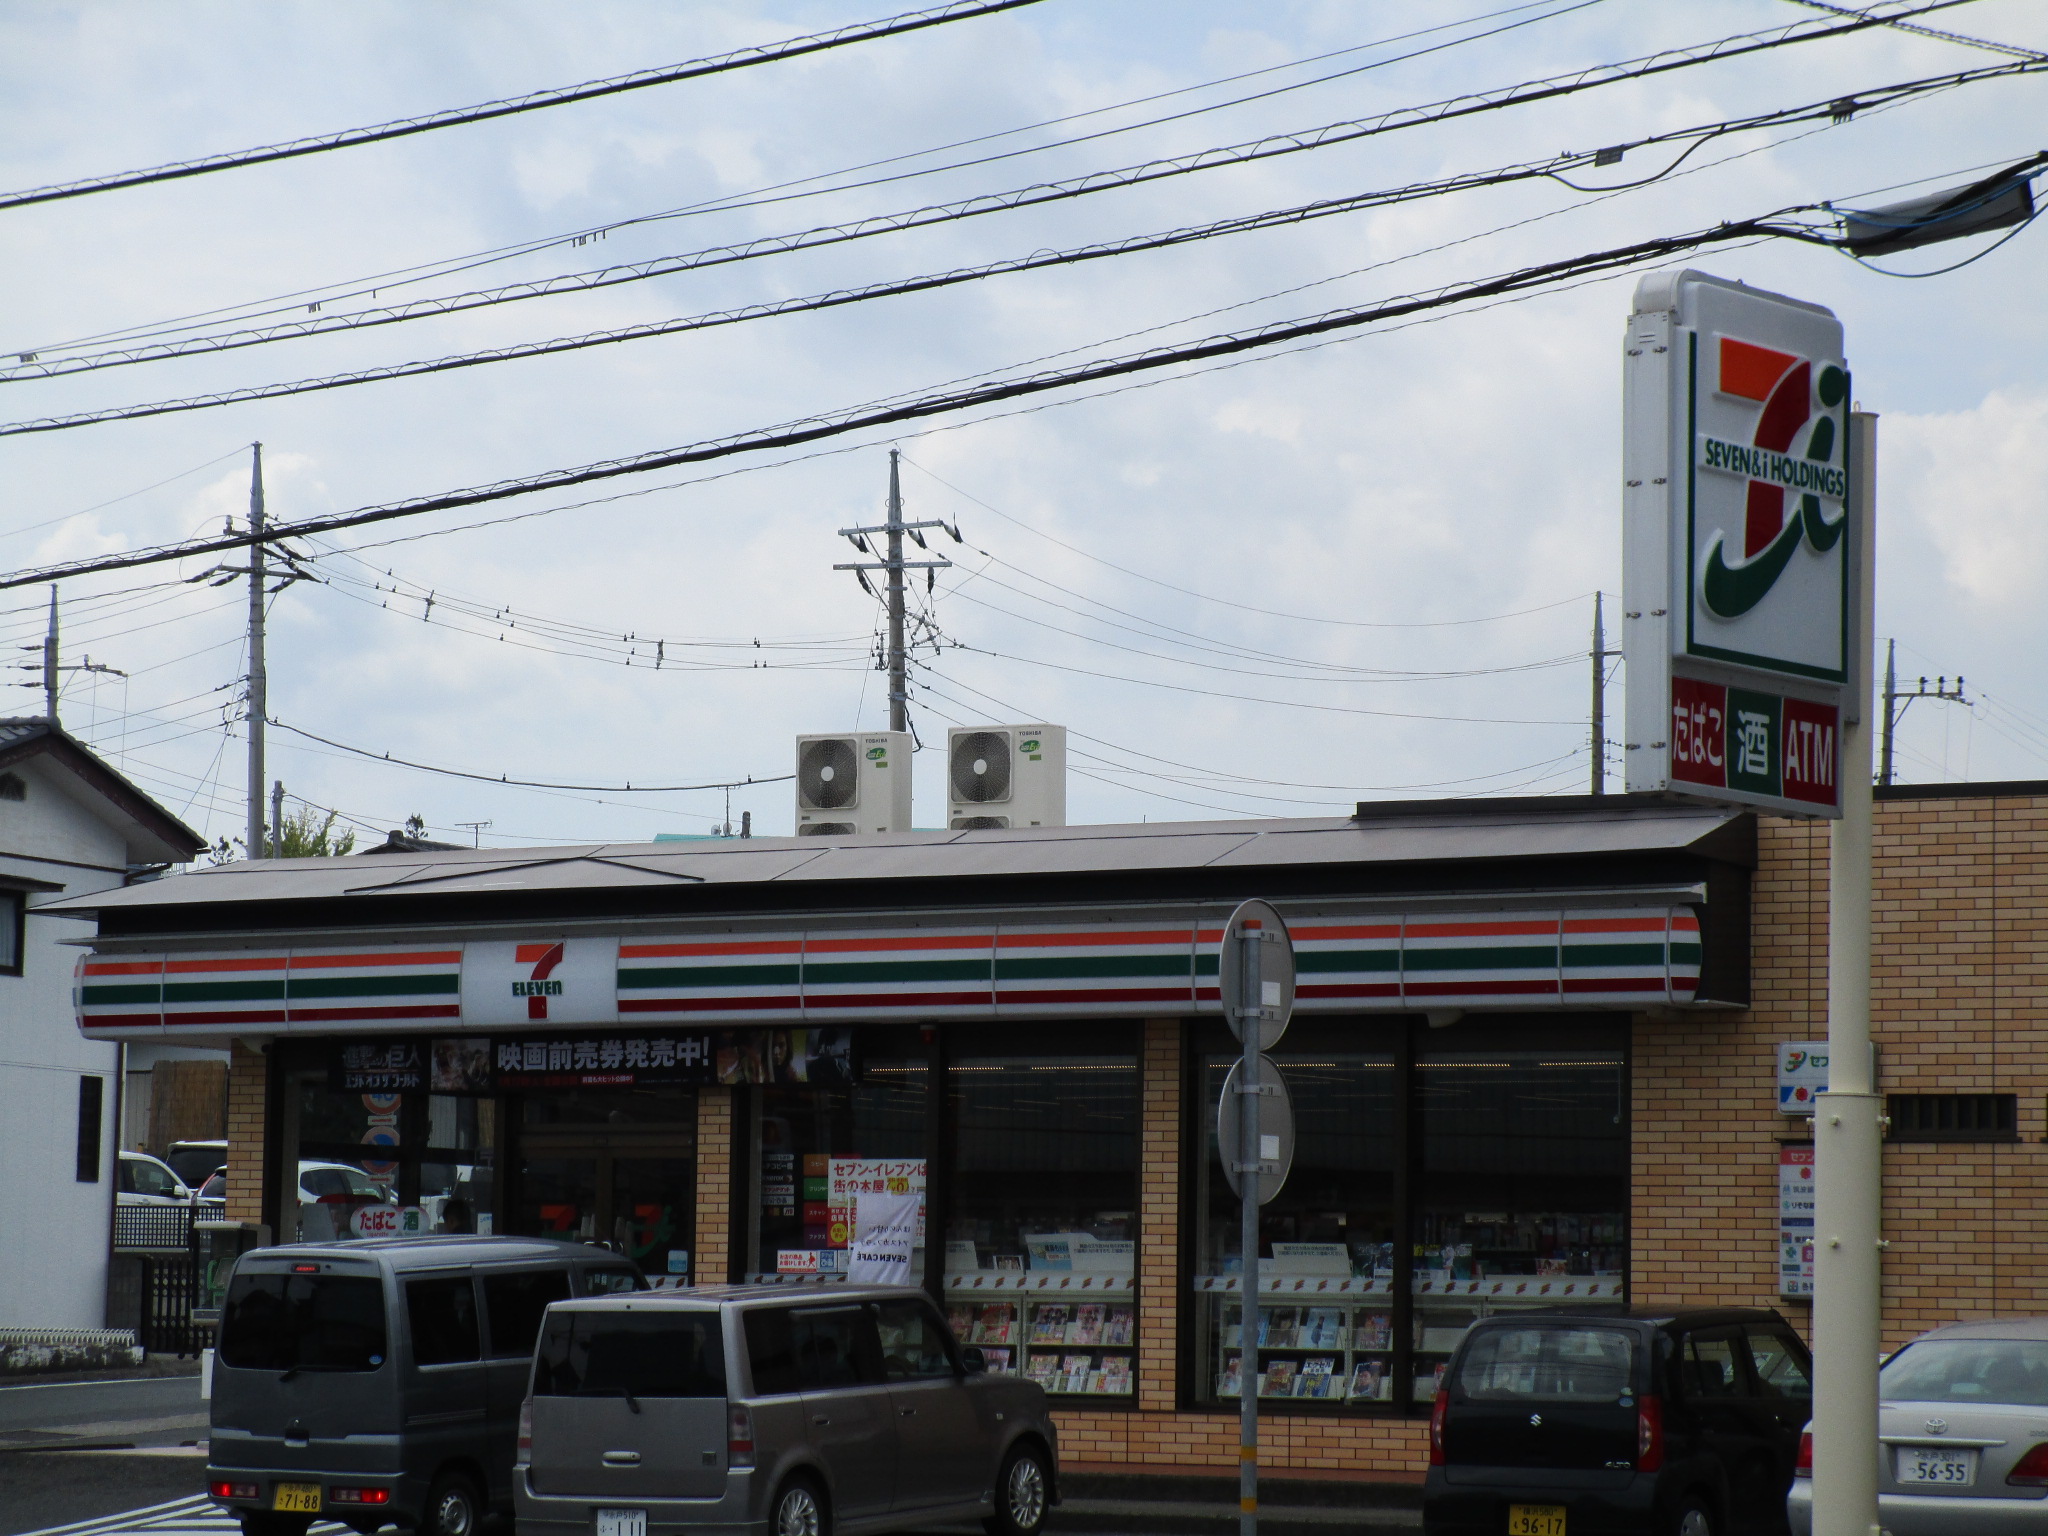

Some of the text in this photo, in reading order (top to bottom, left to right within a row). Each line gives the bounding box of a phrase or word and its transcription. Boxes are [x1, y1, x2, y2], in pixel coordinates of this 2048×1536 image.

[1705, 438, 1845, 497] SEVEN&i HOLDINGS
[1673, 698, 1723, 767] たばこ
[1737, 709, 1770, 775] 酒
[1785, 719, 1834, 787] ATM
[497, 1037, 709, 1071] 映画前売券発売中!
[834, 1179, 885, 1193] 街の本屋
[360, 1211, 396, 1231] たばこ
[403, 1211, 419, 1231] 酒
[1604, 1461, 1631, 1469] ALTO
[1918, 1462, 1966, 1481] 56-55
[285, 1494, 318, 1510] 71-88
[1521, 1517, 1563, 1535] 96-17
